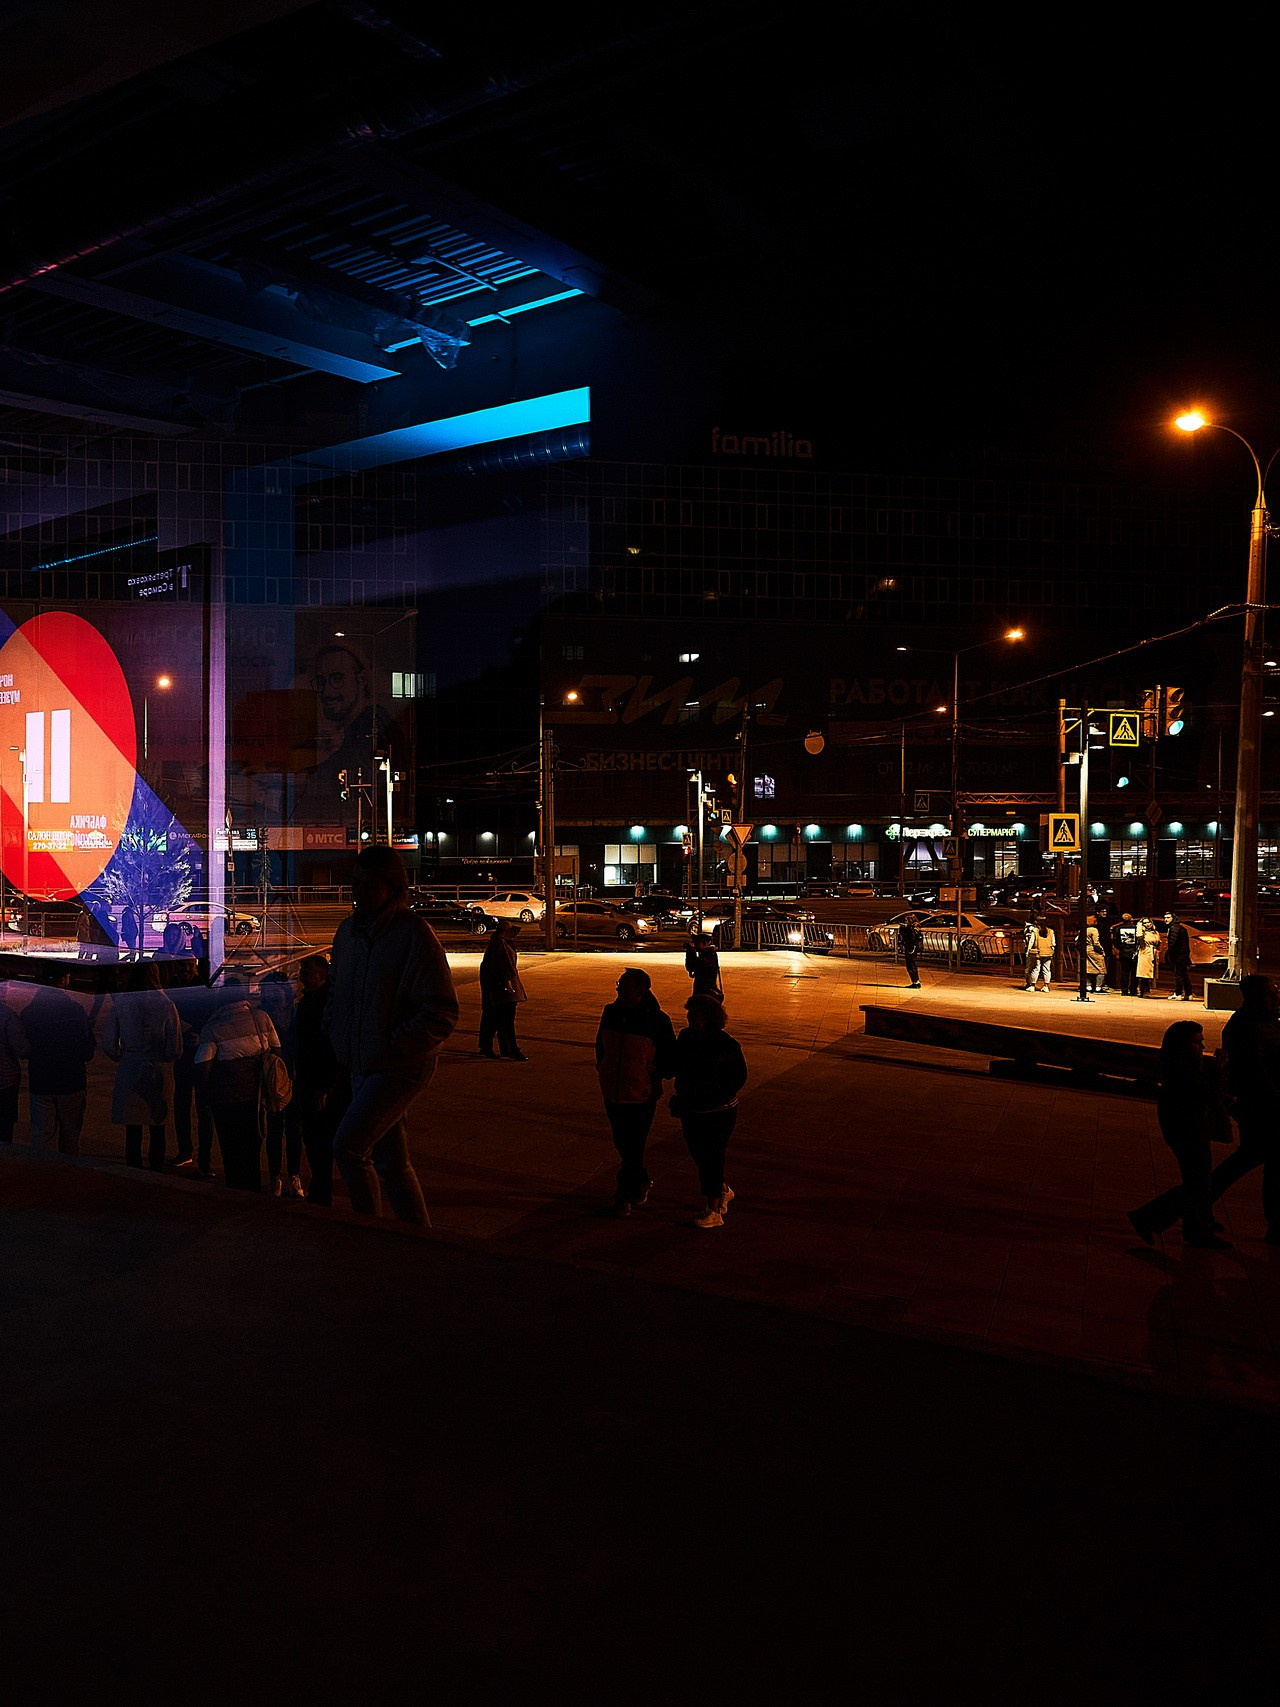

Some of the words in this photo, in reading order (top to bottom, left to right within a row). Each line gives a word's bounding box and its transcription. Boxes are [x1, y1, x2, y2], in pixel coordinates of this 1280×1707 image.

[710, 425, 814, 460] familia
[27, 831, 51, 841] САЛОН
[52, 831, 72, 841] ШТОР
[967, 828, 1020, 837] СУПЕРМАРКЕТ
[315, 833, 343, 844] МТС
